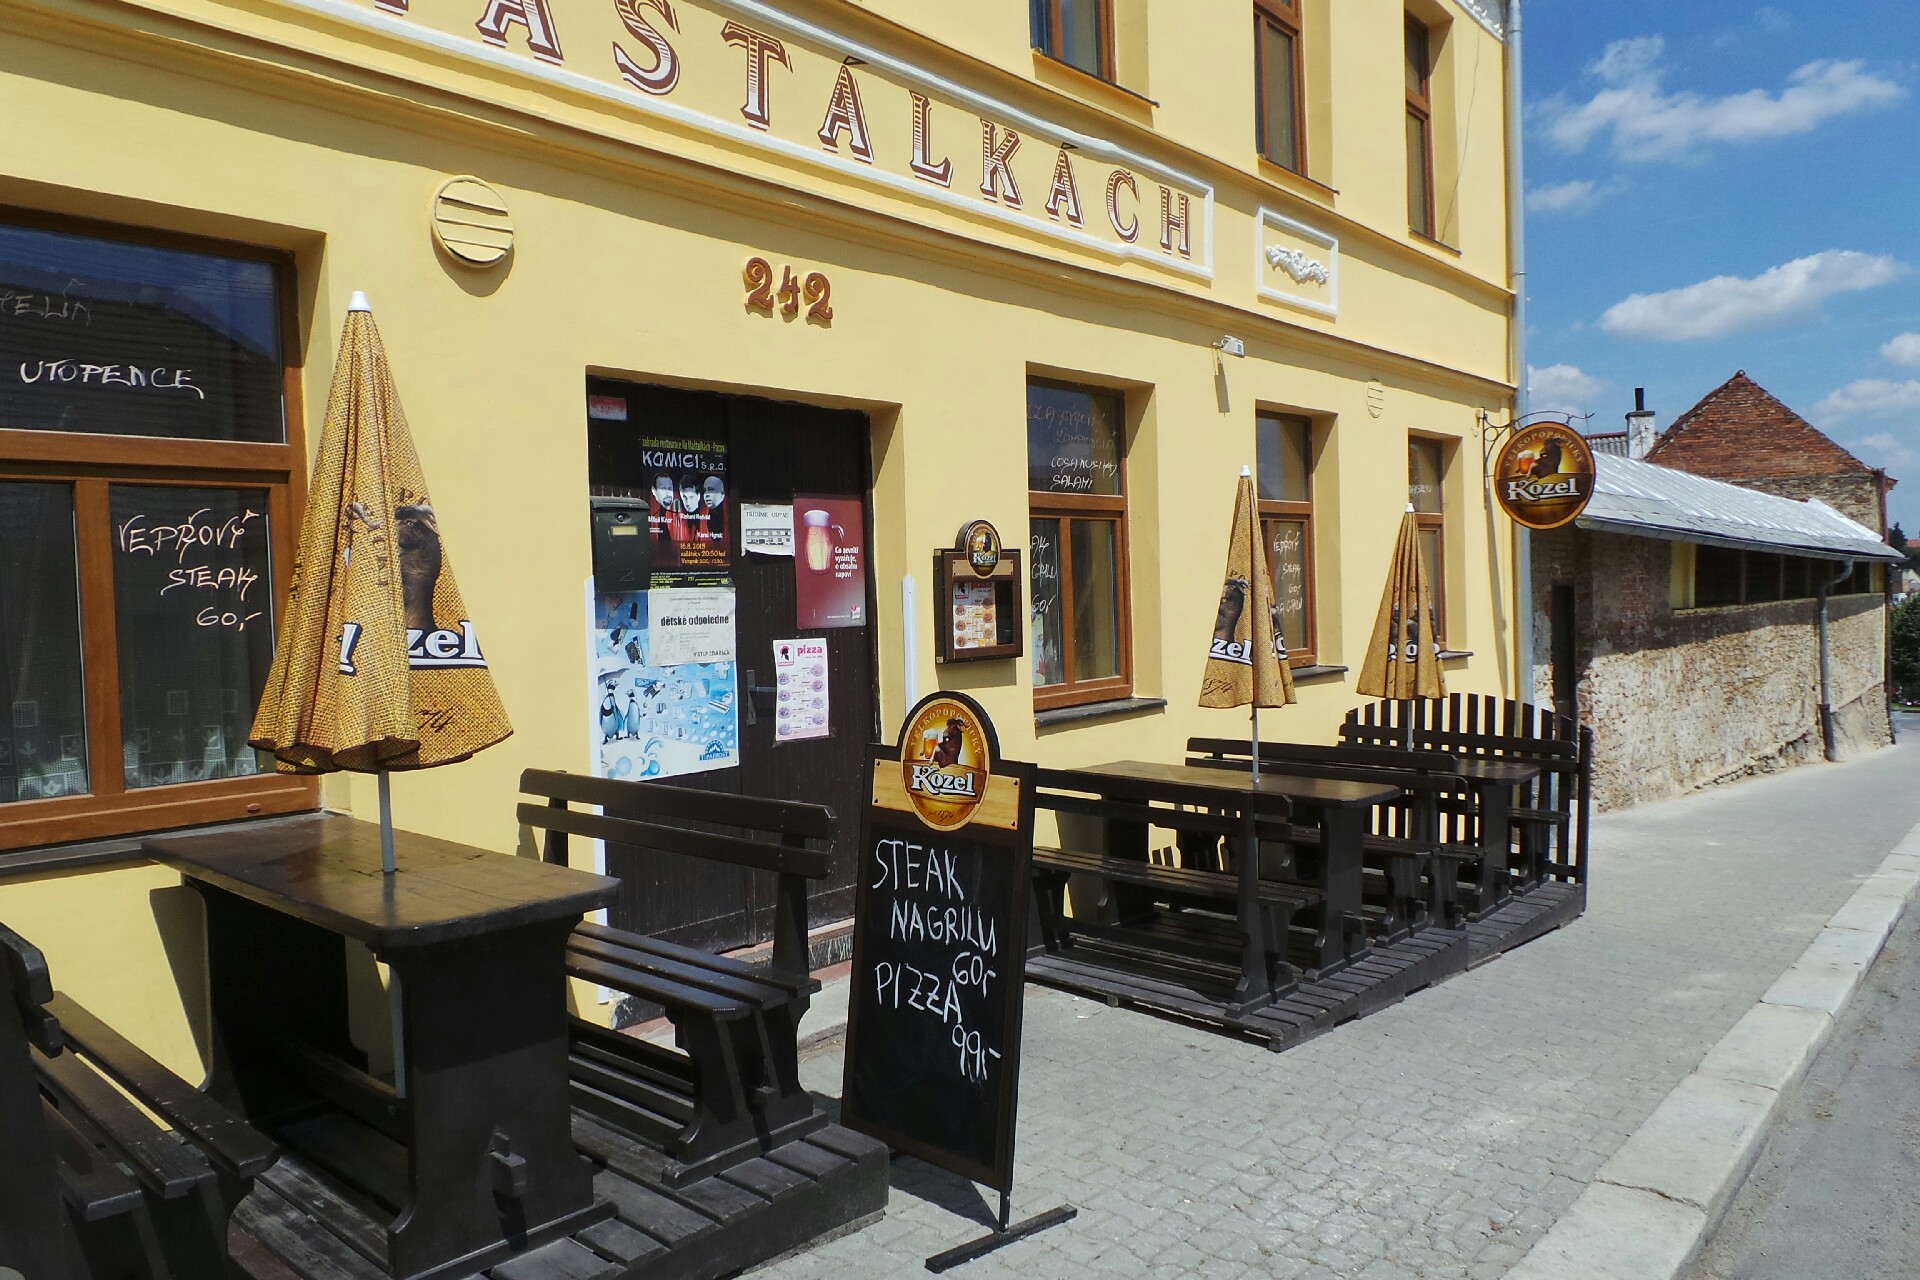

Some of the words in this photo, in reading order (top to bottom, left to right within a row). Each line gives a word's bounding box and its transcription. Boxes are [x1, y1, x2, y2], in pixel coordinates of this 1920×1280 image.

[745, 257, 834, 321] 242
[20, 358, 205, 400] UTOPENCE
[1050, 474, 1093, 490] SALAMI
[1508, 478, 1580, 500] Kozel
[834, 546, 842, 554] Co
[973, 552, 996, 564] Kozel
[160, 565, 258, 602] STEAK
[835, 570, 852, 579] napoví
[196, 606, 262, 632] 60,-
[661, 615, 687, 627] dětské
[688, 615, 729, 627] odpoledne
[797, 645, 823, 656] pizza
[911, 765, 976, 795] Kozel
[872, 838, 965, 901] STEAK
[874, 961, 963, 1024] PIZZA
